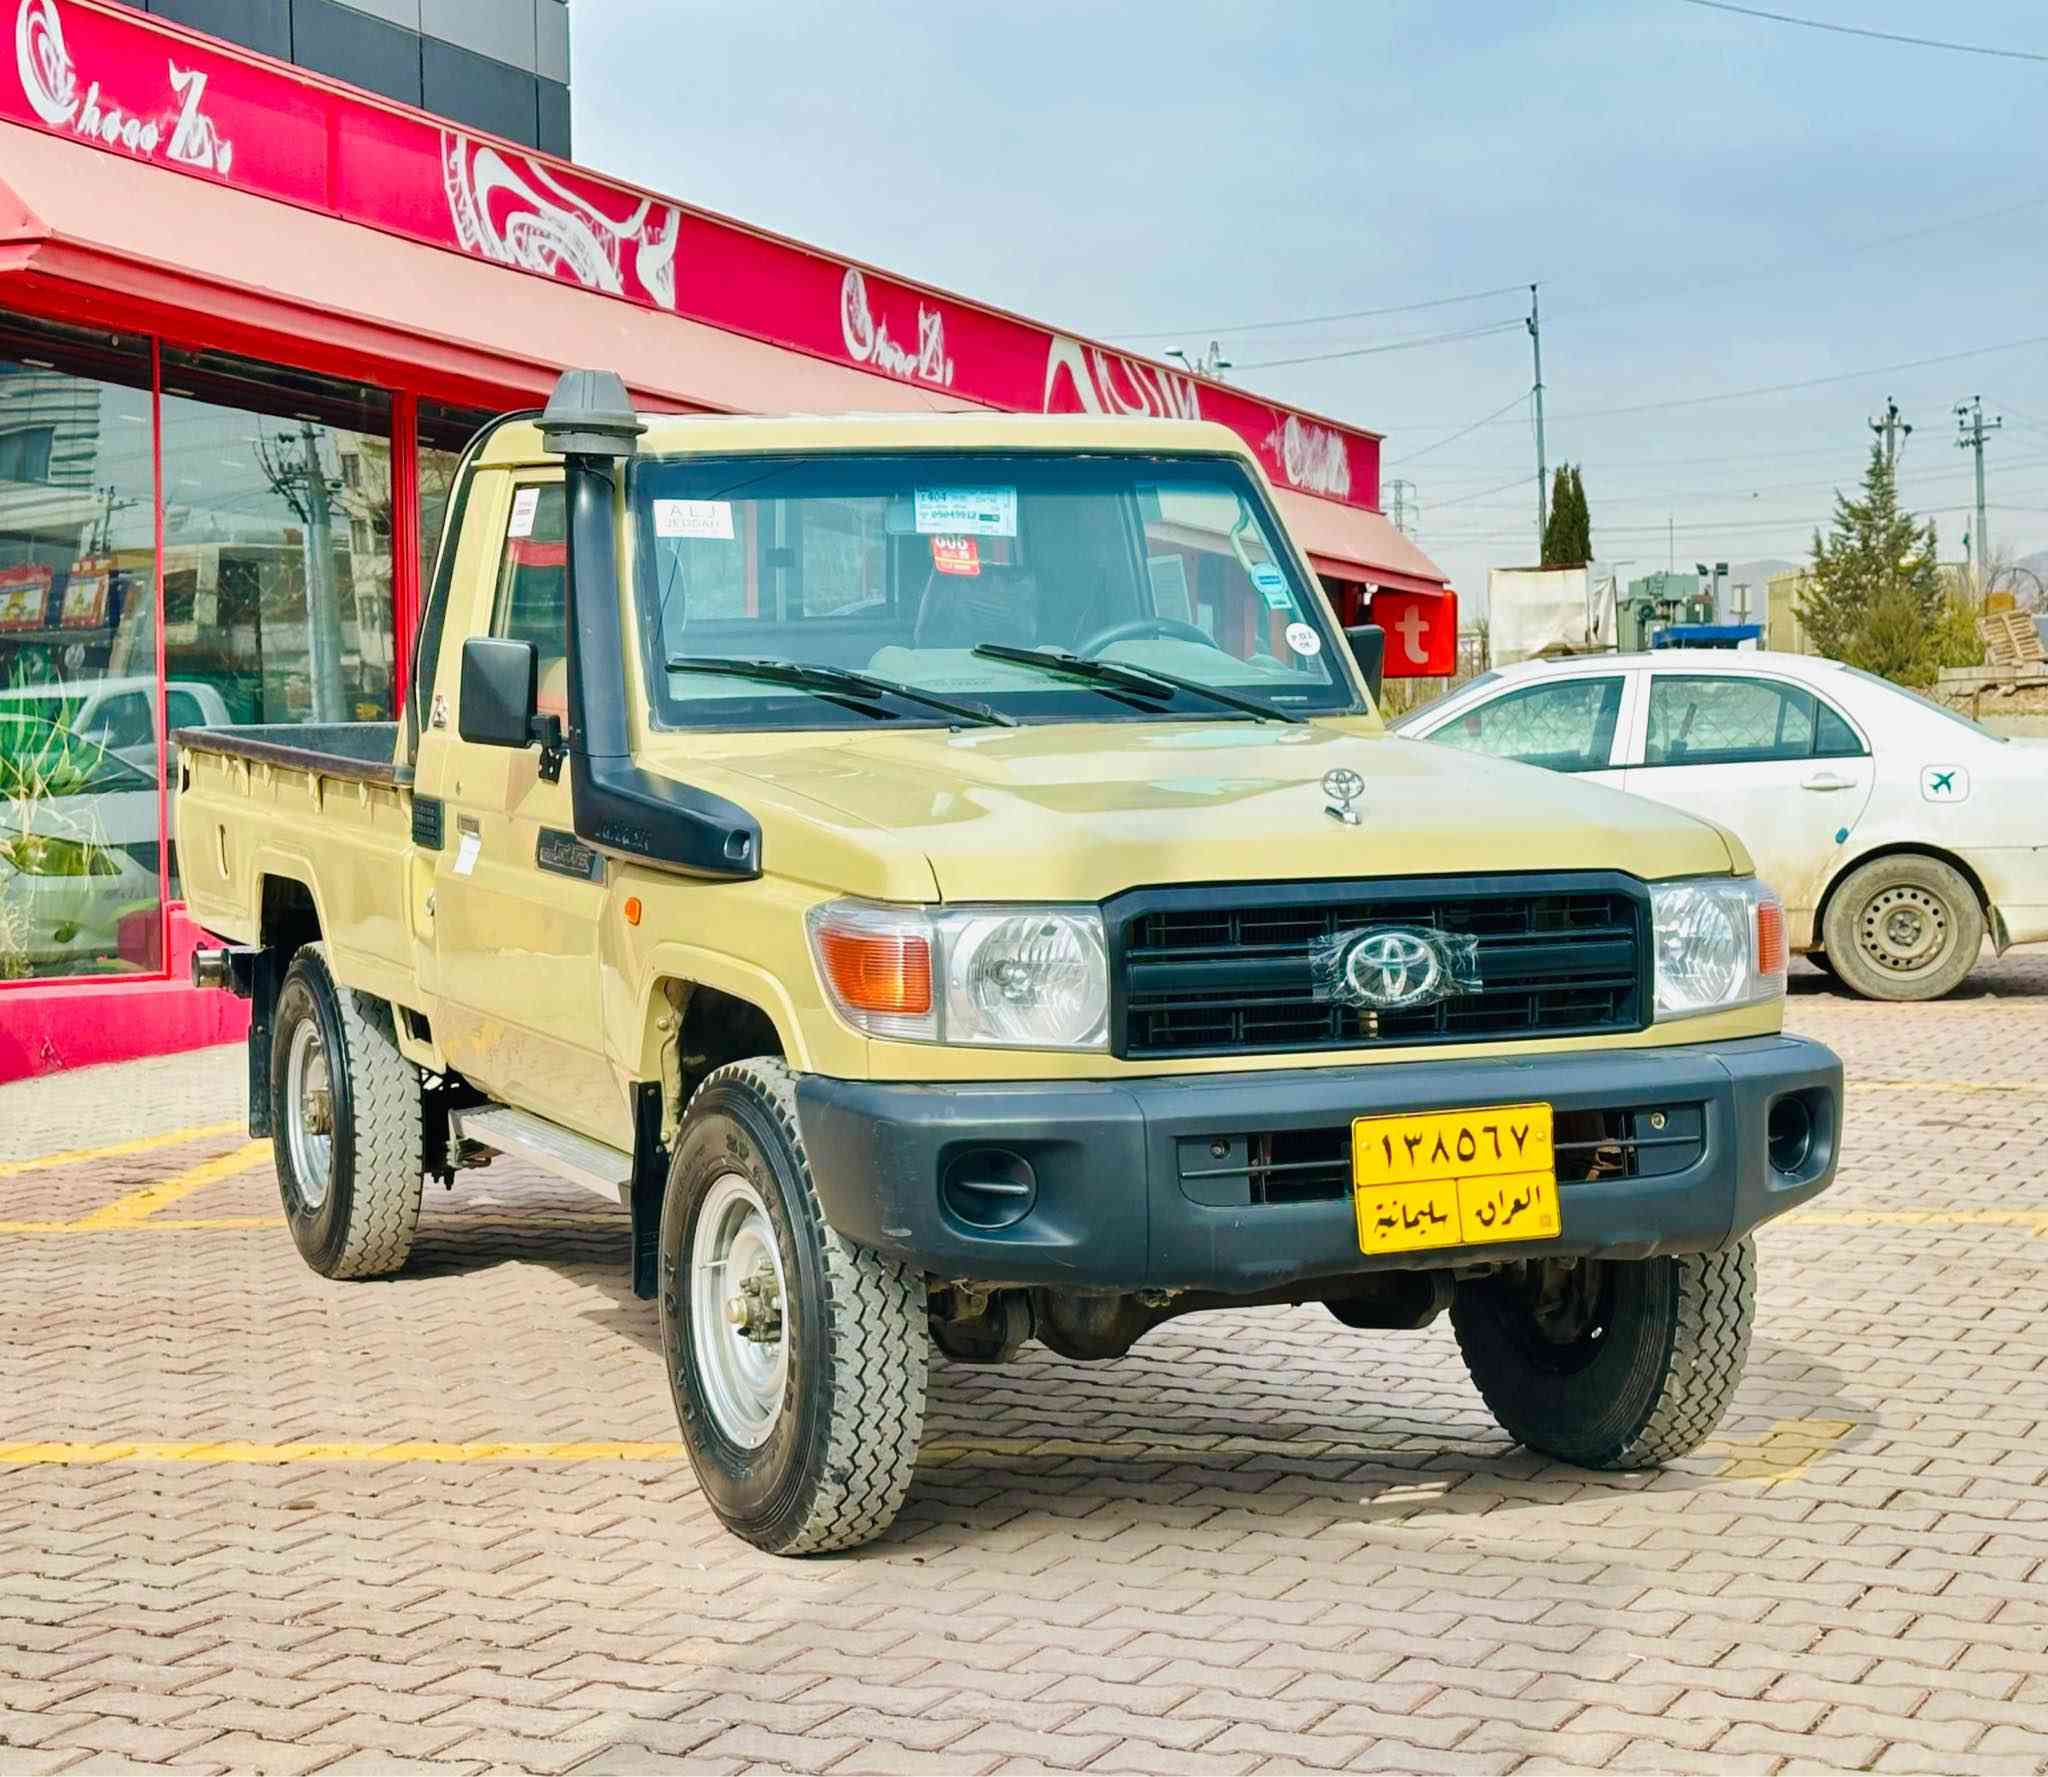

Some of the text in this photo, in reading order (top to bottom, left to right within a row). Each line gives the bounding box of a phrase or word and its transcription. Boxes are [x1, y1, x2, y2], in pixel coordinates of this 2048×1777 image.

[1395, 604, 1430, 664] t
[1381, 1124, 1529, 1168] ١٣٨٥٦٧
[1374, 1200, 1449, 1238] سليمانية
